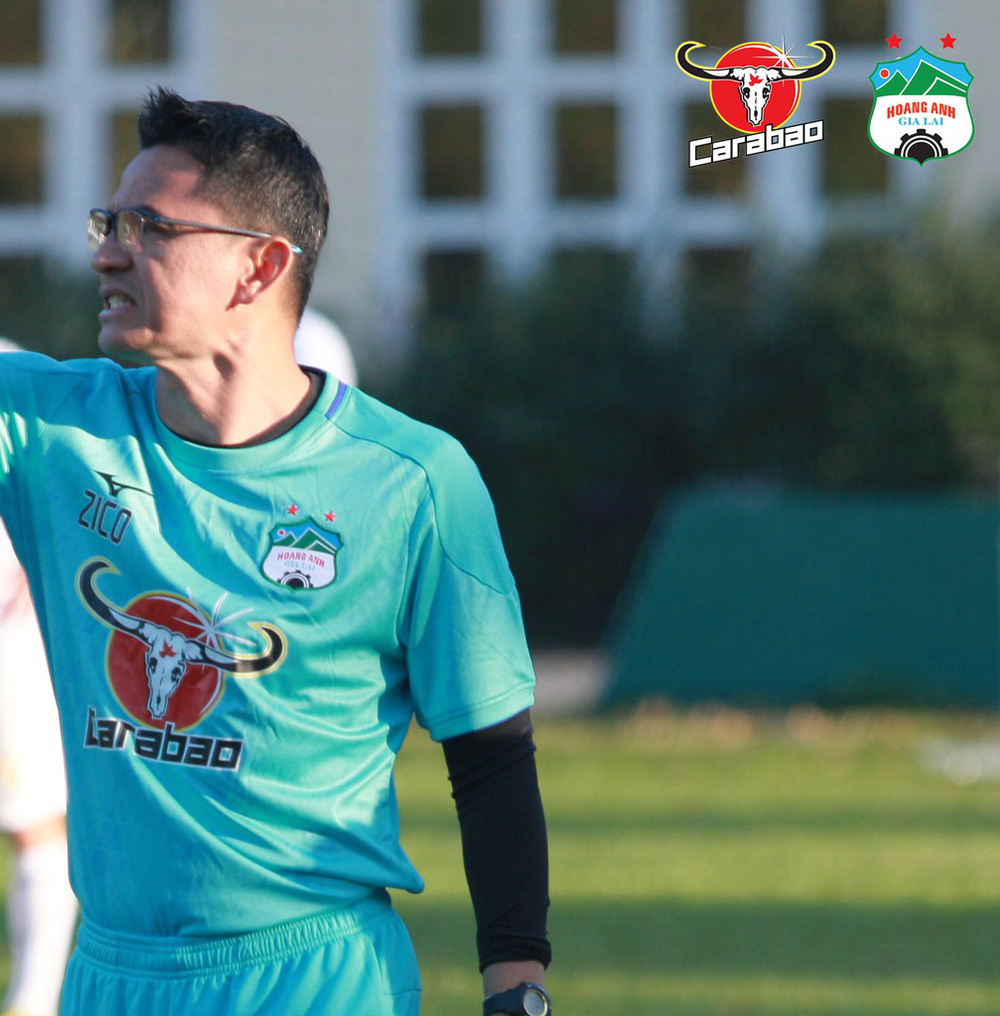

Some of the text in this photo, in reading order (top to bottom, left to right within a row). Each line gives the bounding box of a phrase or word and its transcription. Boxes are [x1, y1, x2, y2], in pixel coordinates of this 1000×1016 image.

[78, 489, 132, 544] ZICO
[277, 551, 326, 568] HOANG ANH
